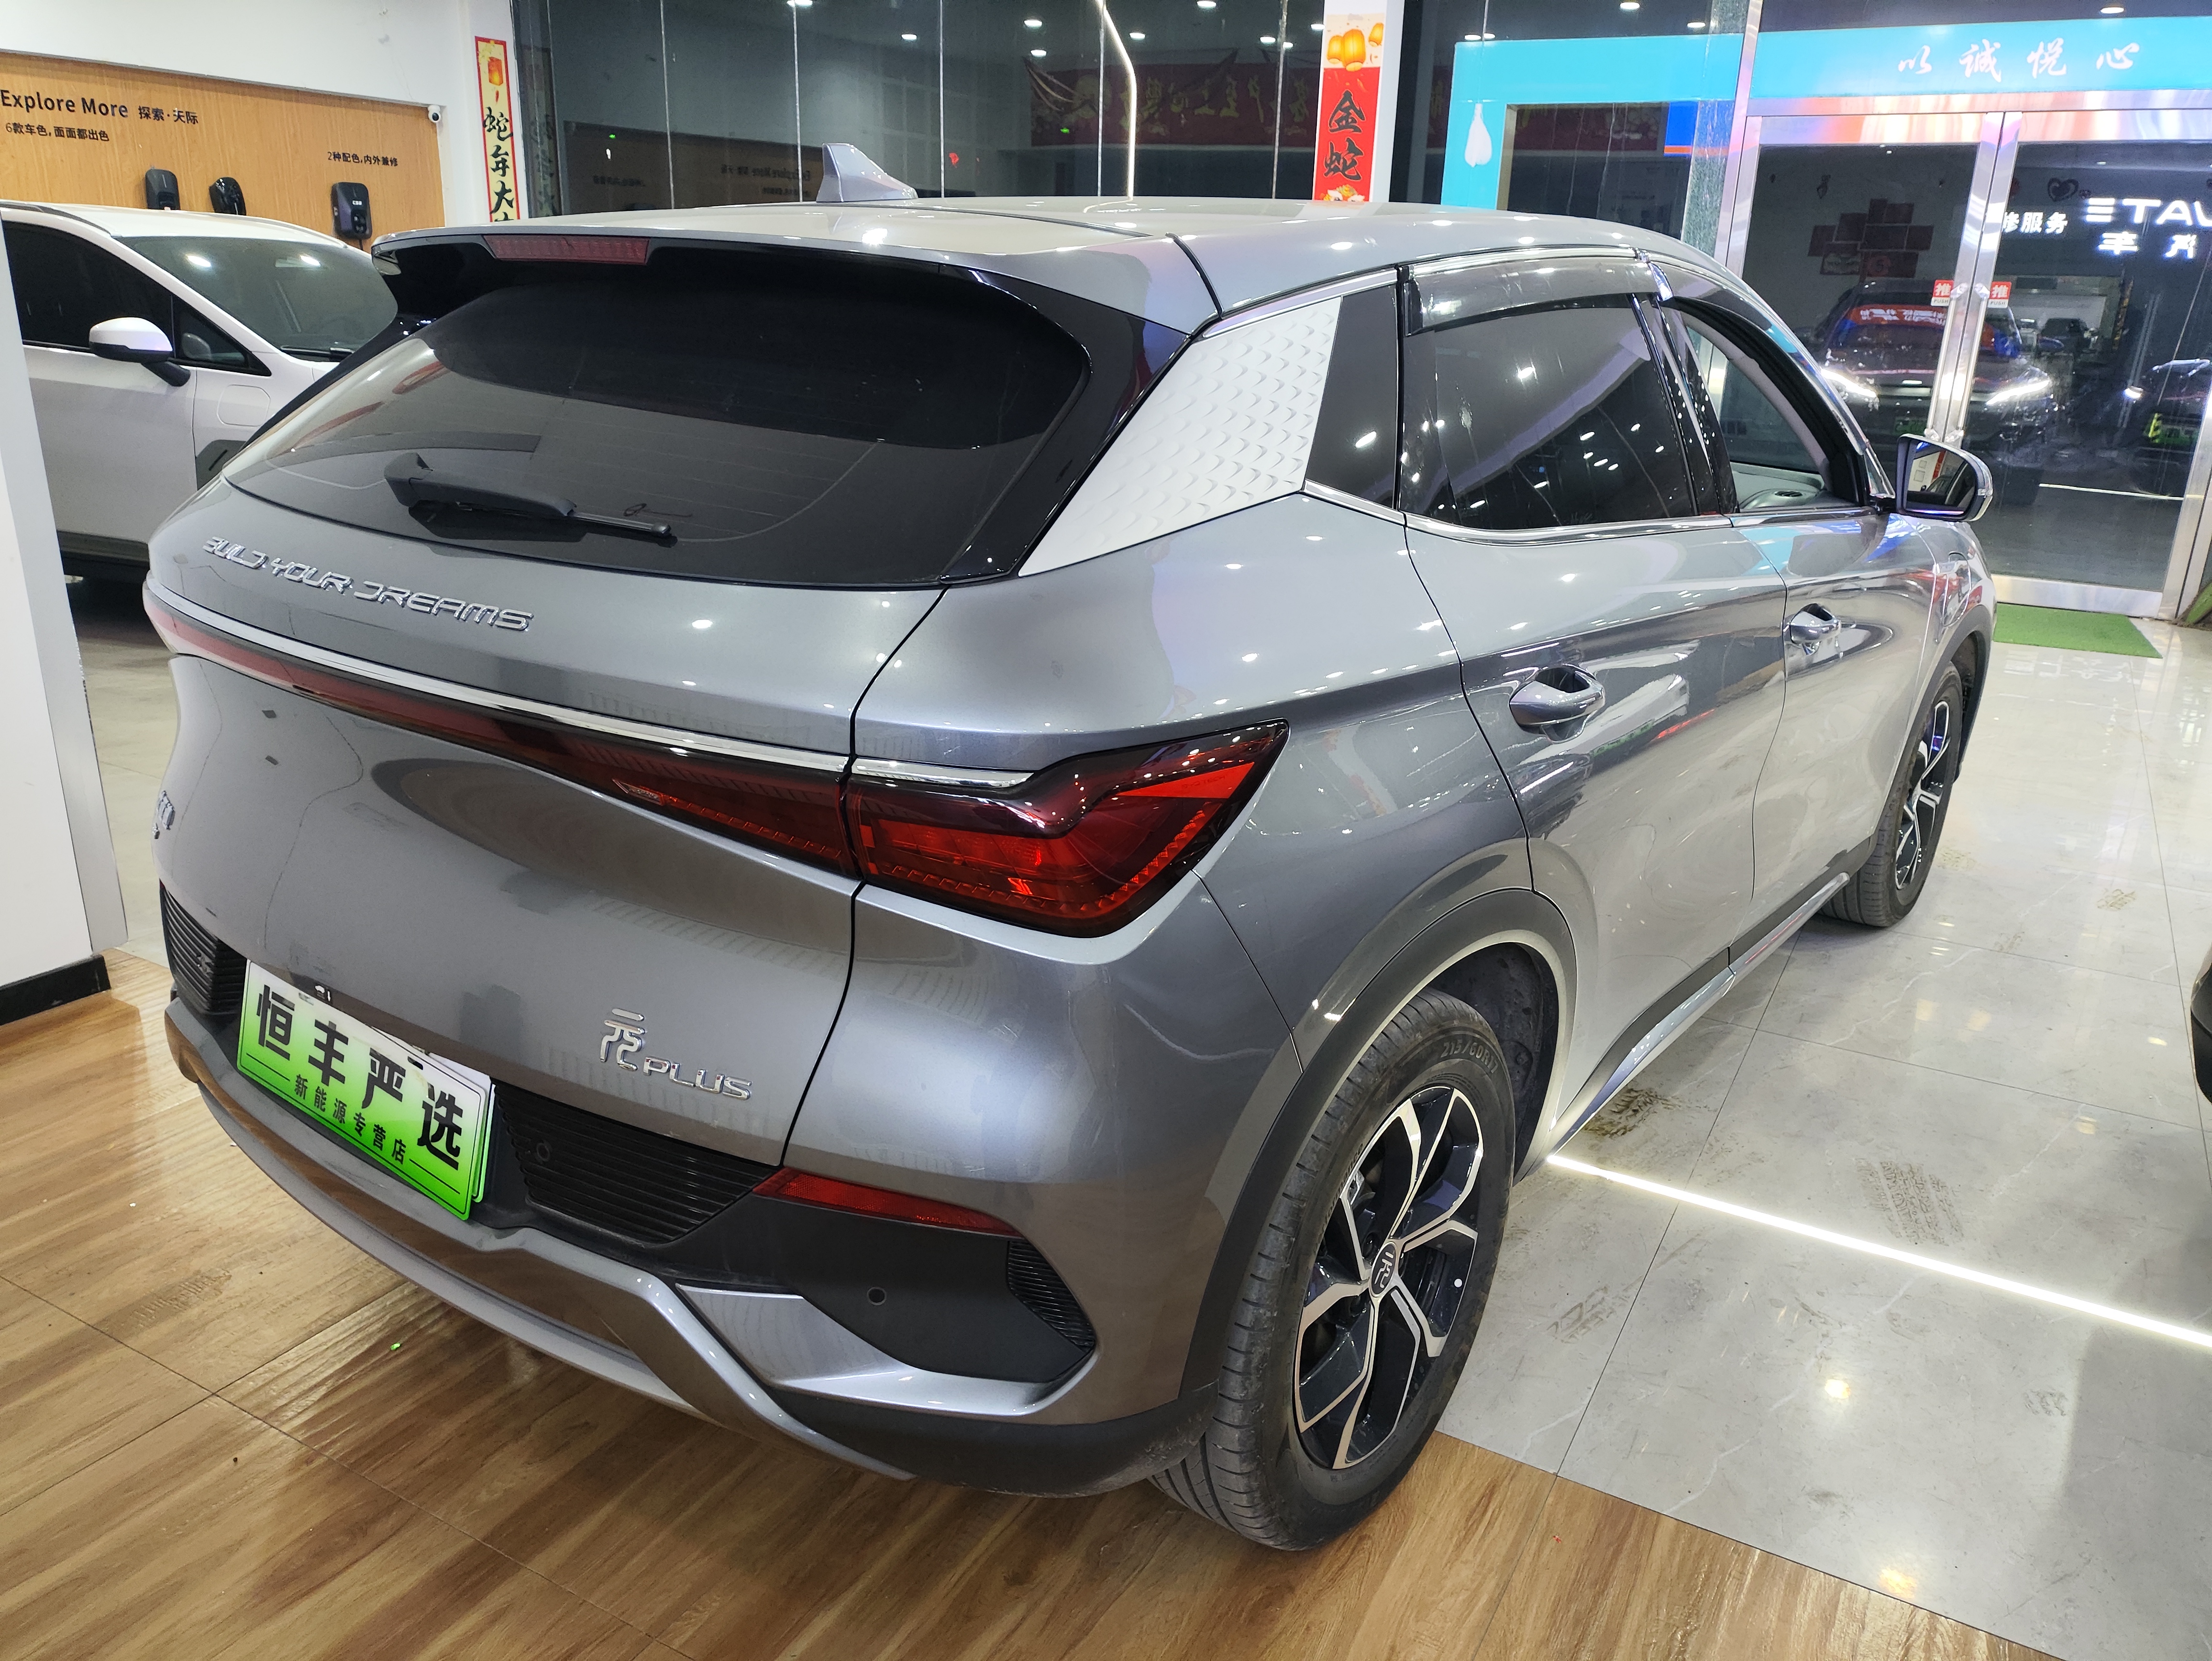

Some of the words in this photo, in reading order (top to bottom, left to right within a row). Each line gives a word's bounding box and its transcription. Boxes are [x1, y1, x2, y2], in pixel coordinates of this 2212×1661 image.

[0, 89, 76, 113] Explore
[82, 97, 129, 118] More
[482, 106, 515, 221] 蛇年大
[1323, 89, 1365, 181] 金蛇
[1935, 283, 1952, 296] 推
[1992, 285, 2009, 298] 推
[270, 557, 354, 595] YOUR
[354, 580, 534, 631] DREAMS
[256, 984, 464, 1171] 恒丰严选
[643, 1056, 753, 1100] PLUS
[1440, 1039, 1499, 1074] 215/60R17
[294, 1074, 407, 1164] 新能源专营店
